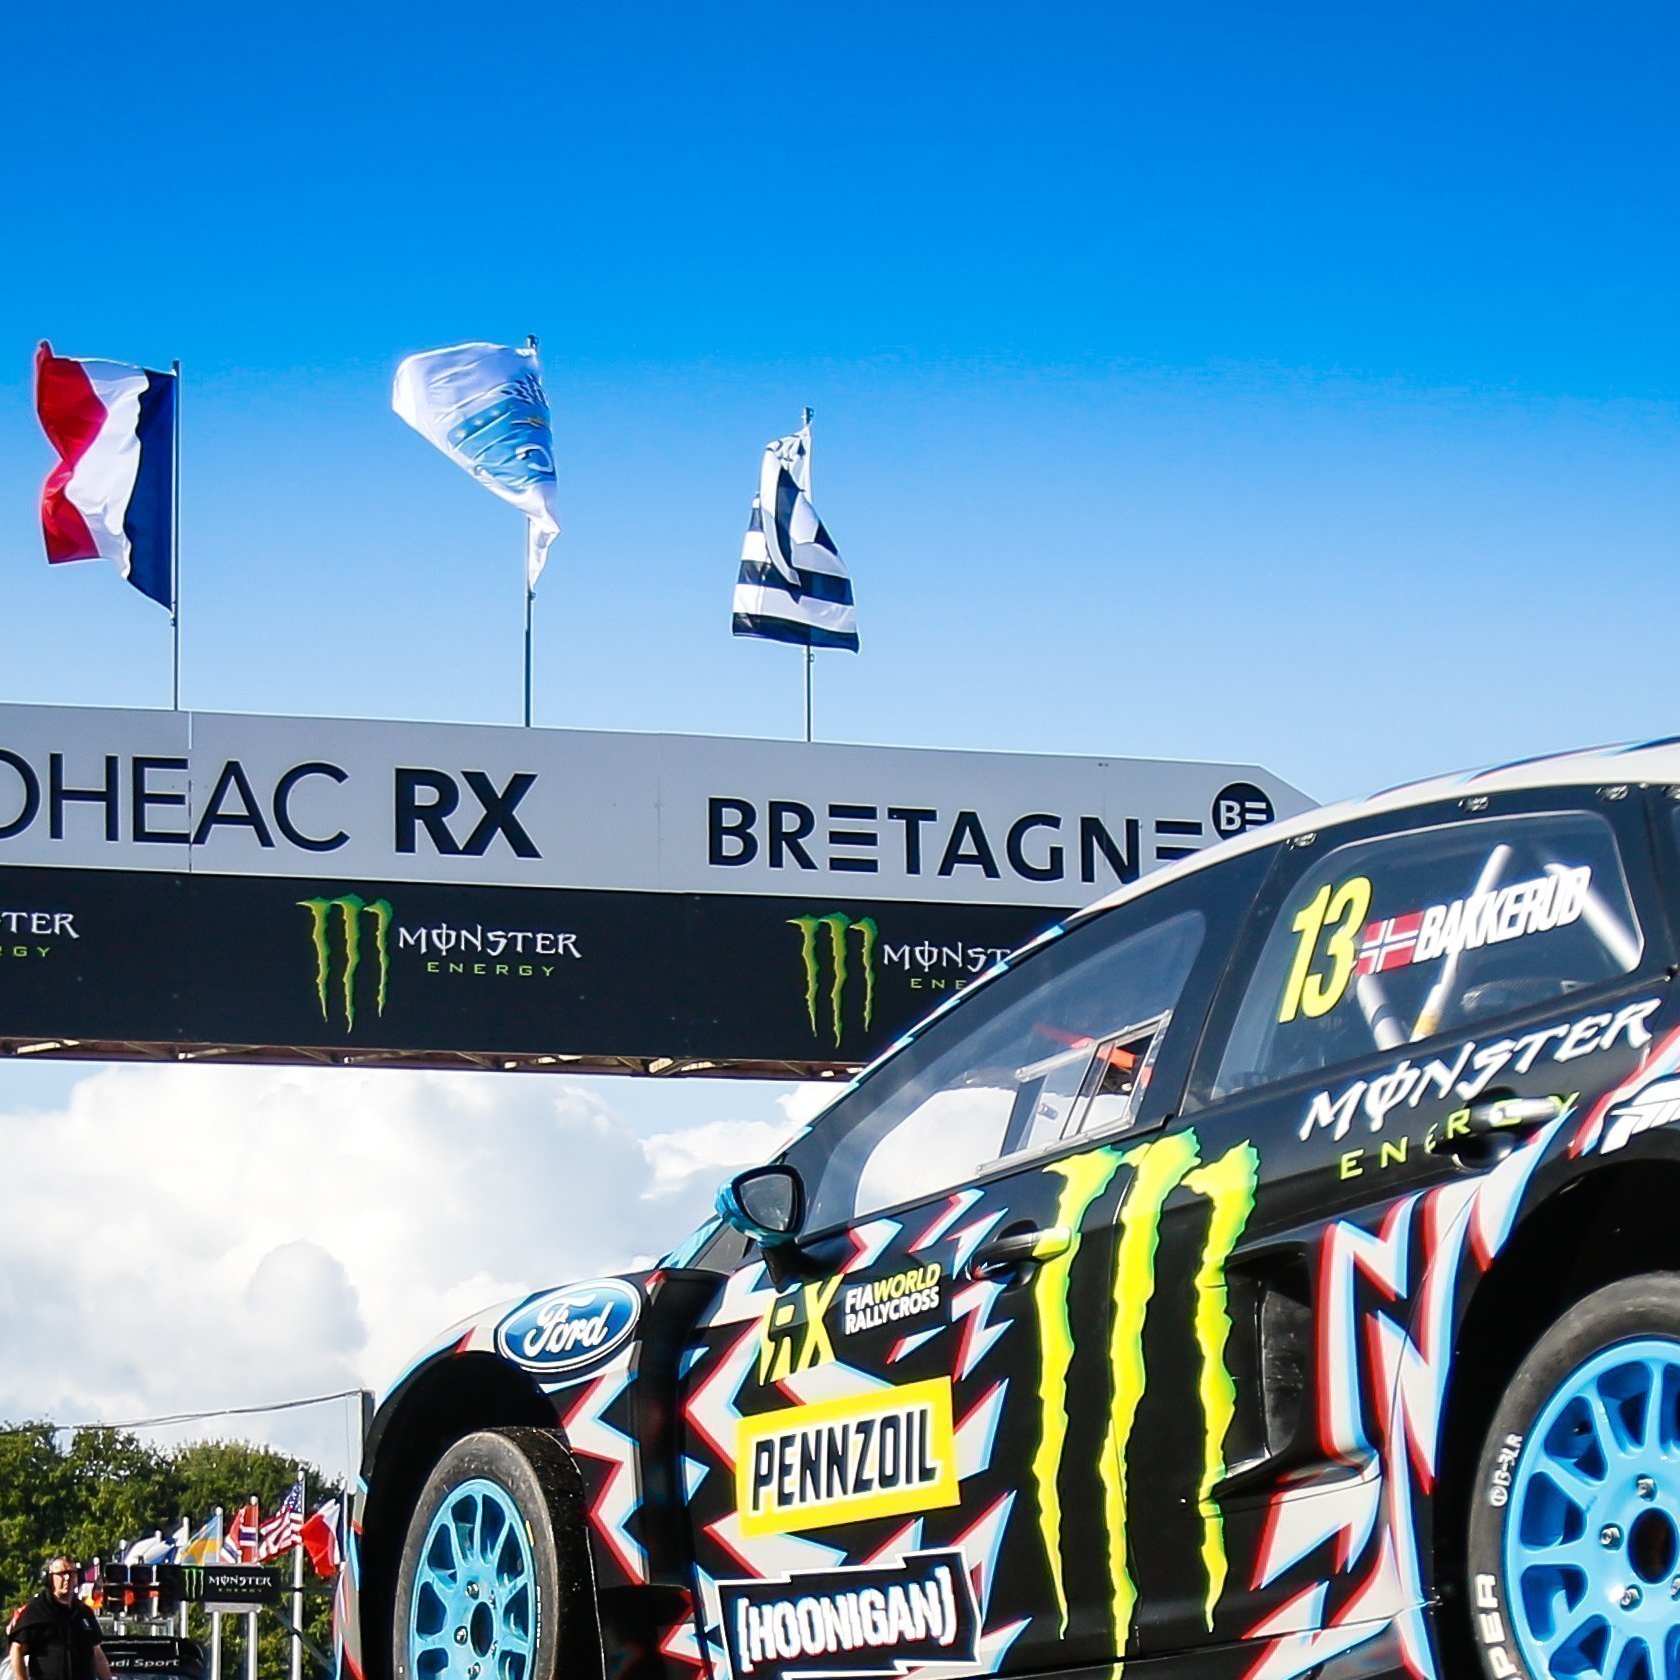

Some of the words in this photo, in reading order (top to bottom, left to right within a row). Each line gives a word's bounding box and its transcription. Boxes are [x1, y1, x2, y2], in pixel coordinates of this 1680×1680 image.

[394, 768, 542, 860] RX
[399, 923, 582, 959] MONSTER
[883, 941, 1010, 972] MONST
[1278, 877, 1373, 1023] 13
[427, 961, 556, 977] ENERGY
[1299, 999, 1662, 1142] MONSTER
[522, 1296, 609, 1356] Ford
[845, 1286, 940, 1335] RALLYCROSS
[753, 1408, 938, 1512] PENNZOIL
[209, 1575, 272, 1587] MONSTER
[107, 1659, 129, 1668] udi
[134, 1659, 179, 1668] Sport
